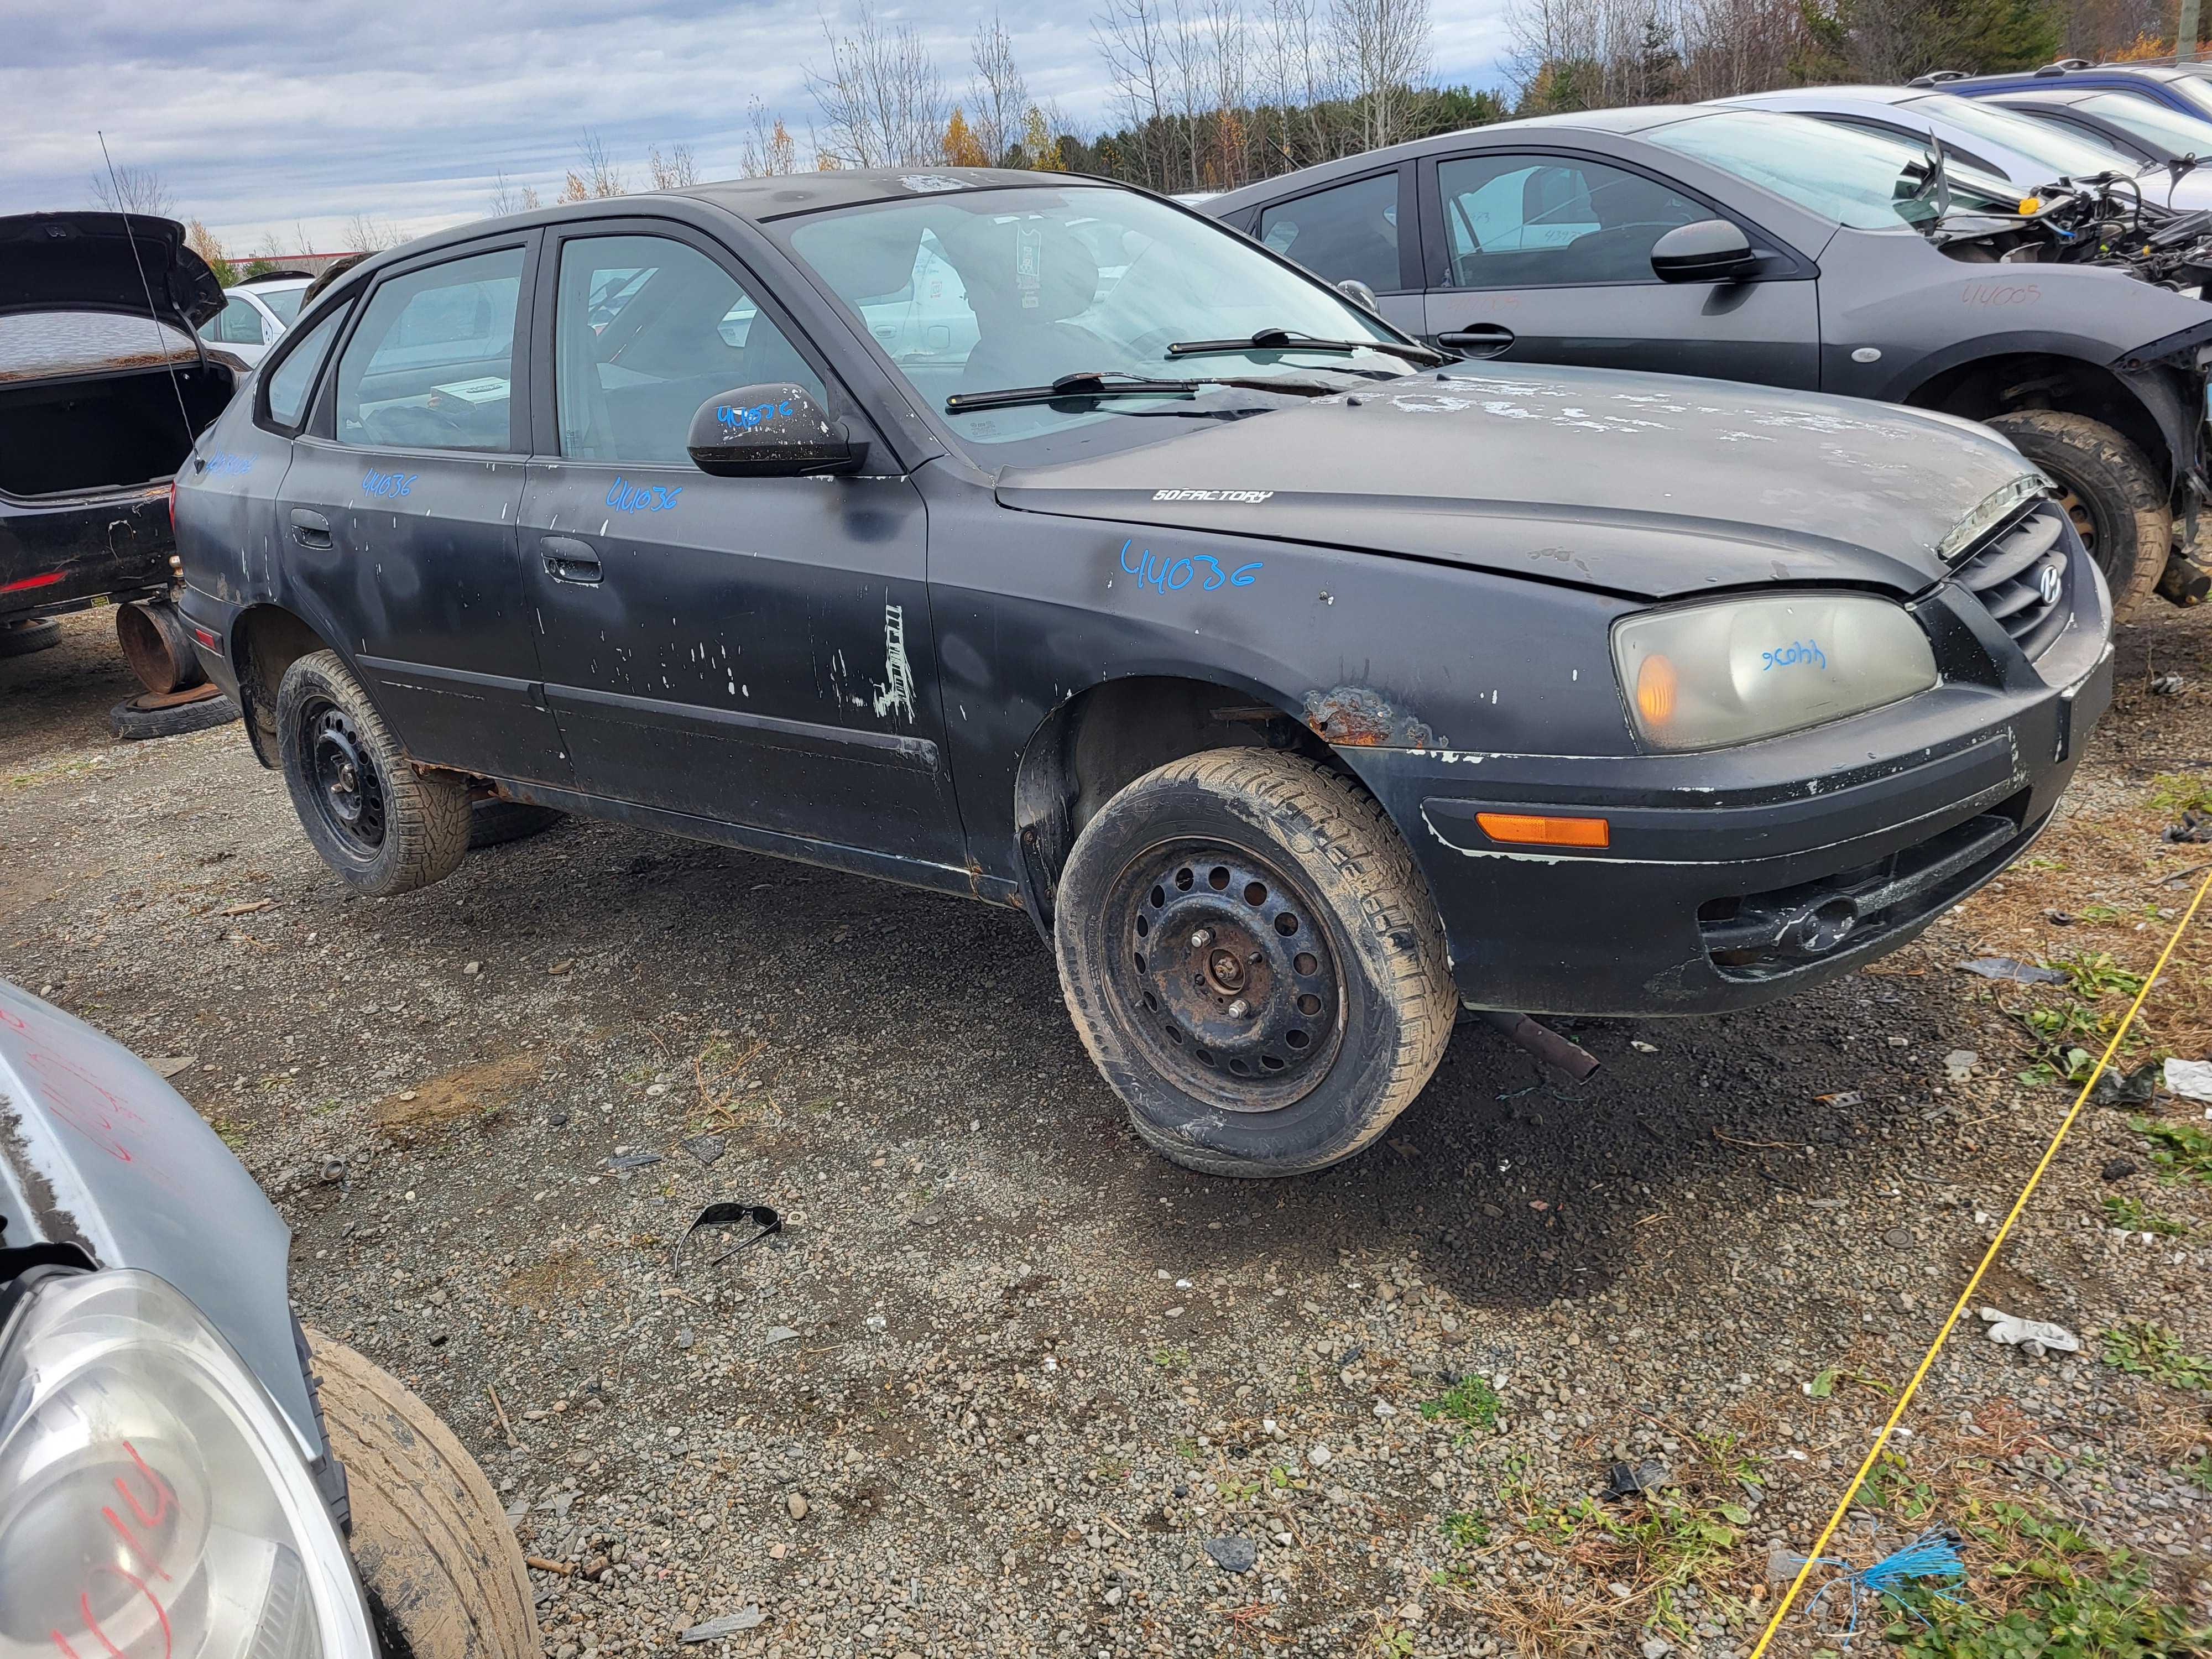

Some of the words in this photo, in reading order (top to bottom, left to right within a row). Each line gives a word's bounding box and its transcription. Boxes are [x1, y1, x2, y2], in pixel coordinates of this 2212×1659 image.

[362, 467, 418, 498] 44036
[606, 476, 683, 514] 44036
[1120, 539, 1264, 594] 44036
